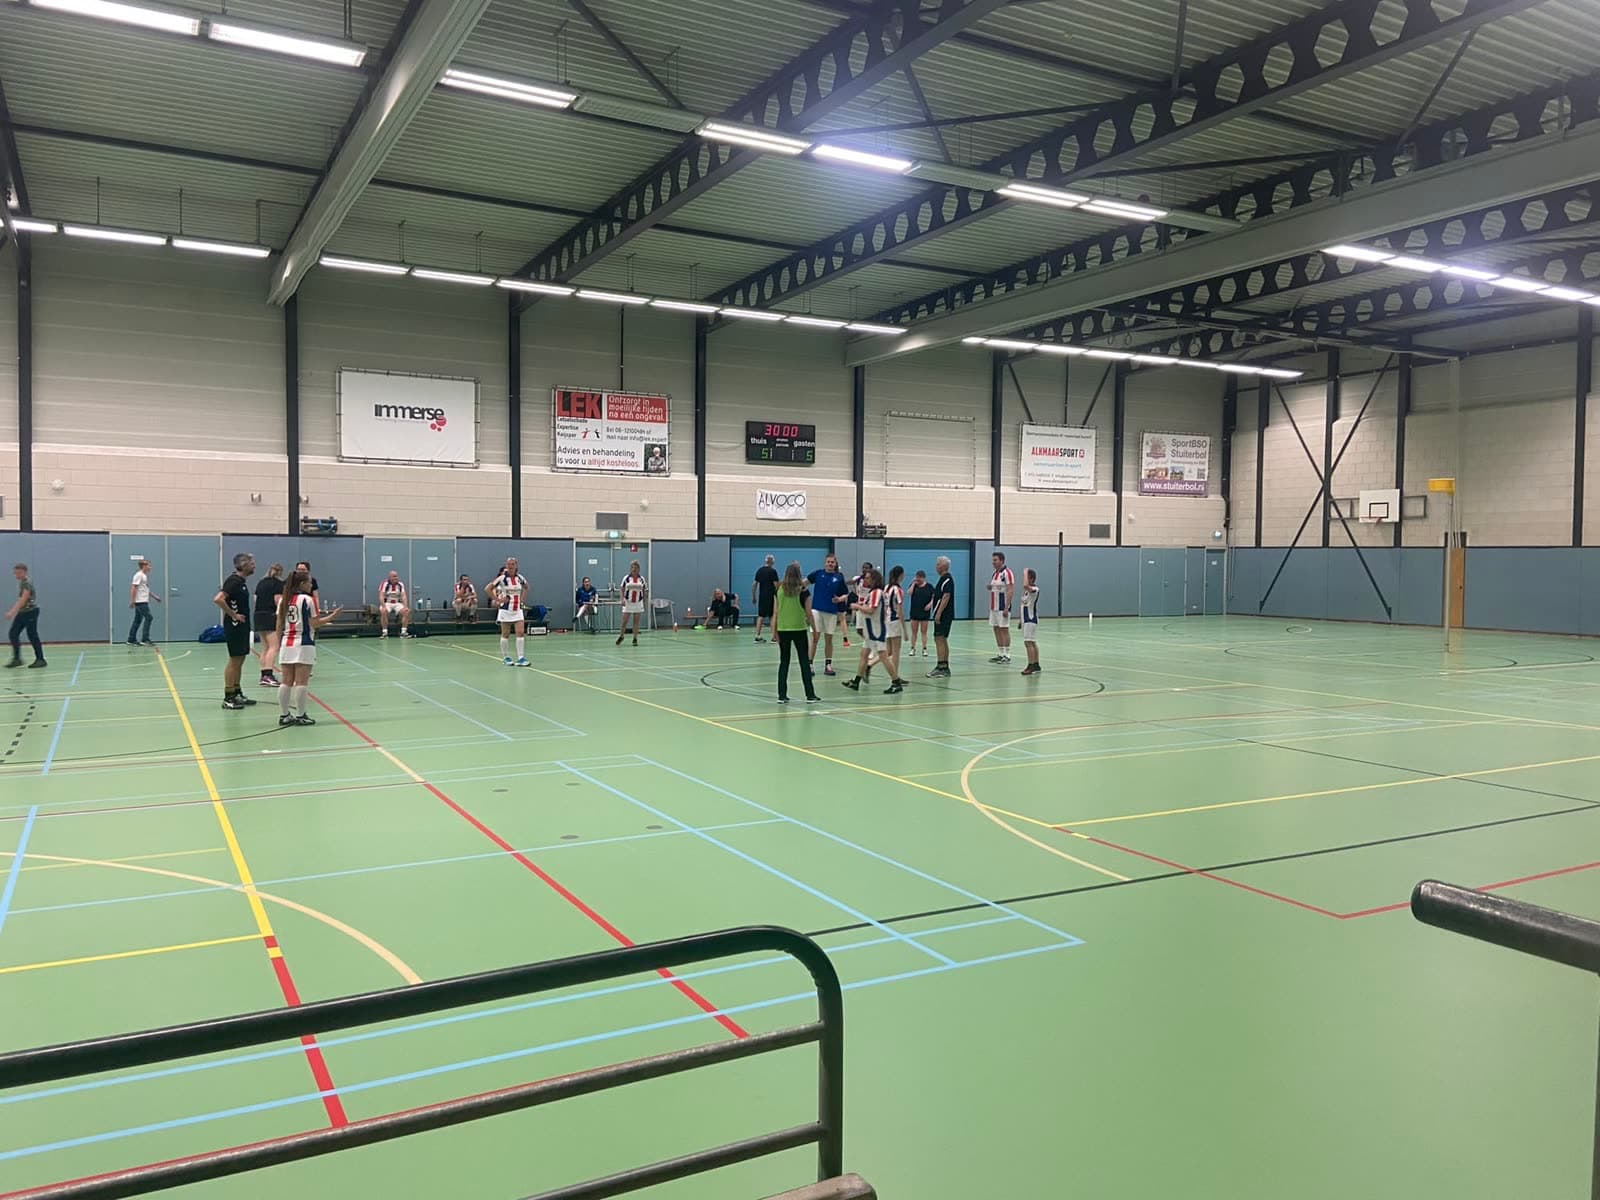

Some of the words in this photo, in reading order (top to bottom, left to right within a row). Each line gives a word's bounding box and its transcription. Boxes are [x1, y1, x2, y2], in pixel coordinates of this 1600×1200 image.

[557, 391, 601, 419] LEK
[750, 437, 767, 445] thuis
[793, 440, 815, 448] gasten
[1171, 439, 1207, 449] SportBSO
[558, 446, 580, 455] Advies
[592, 448, 636, 458] behandeling
[761, 448, 769, 459] 5
[806, 450, 813, 461] 5
[1171, 449, 1207, 459] Stuiterbol
[558, 457, 563, 465] is
[588, 458, 605, 467] altijd
[759, 493, 806, 507] ALVOCO
